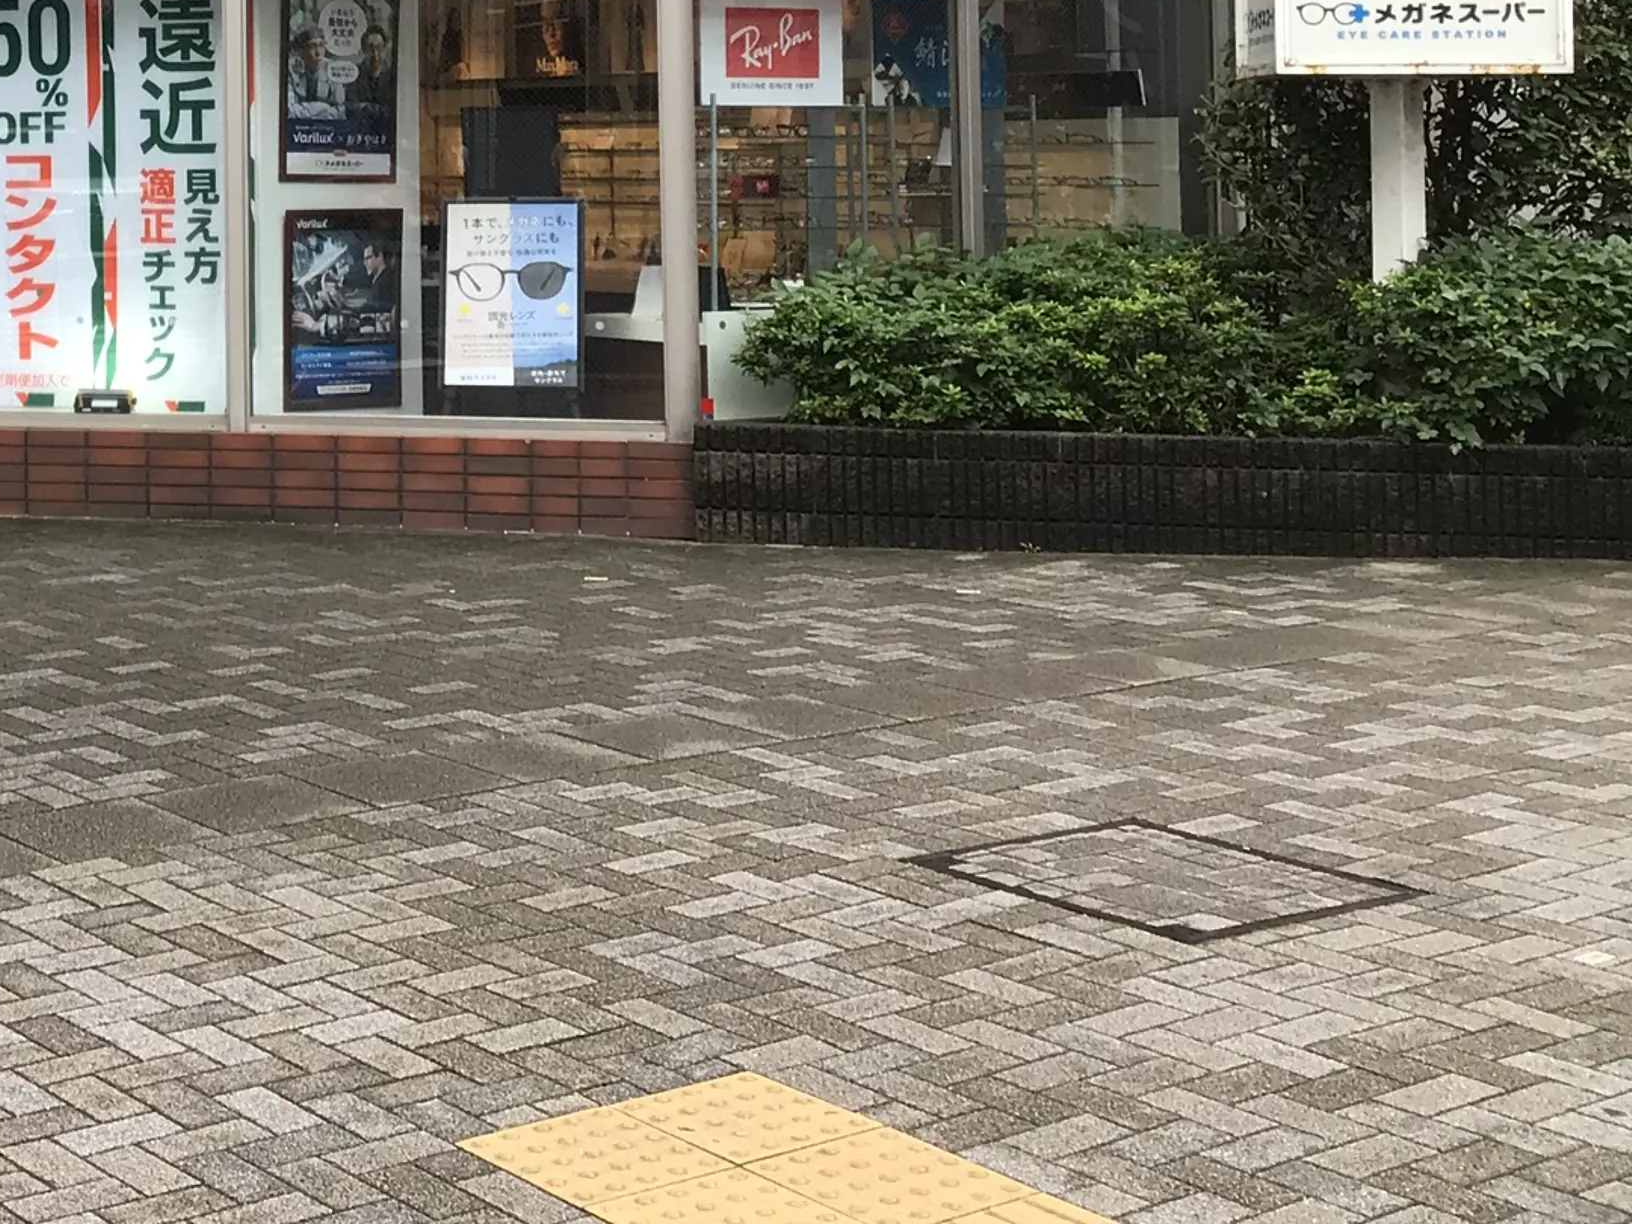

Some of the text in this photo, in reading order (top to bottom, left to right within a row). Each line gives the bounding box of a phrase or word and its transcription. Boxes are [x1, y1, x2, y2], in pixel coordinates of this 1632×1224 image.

[1337, 29, 1508, 40] EYE CARE STATION
[1374, 2, 1546, 24] メガネスーパー
[5, 154, 59, 361] コンタクト
[183, 168, 221, 285] 見え方
